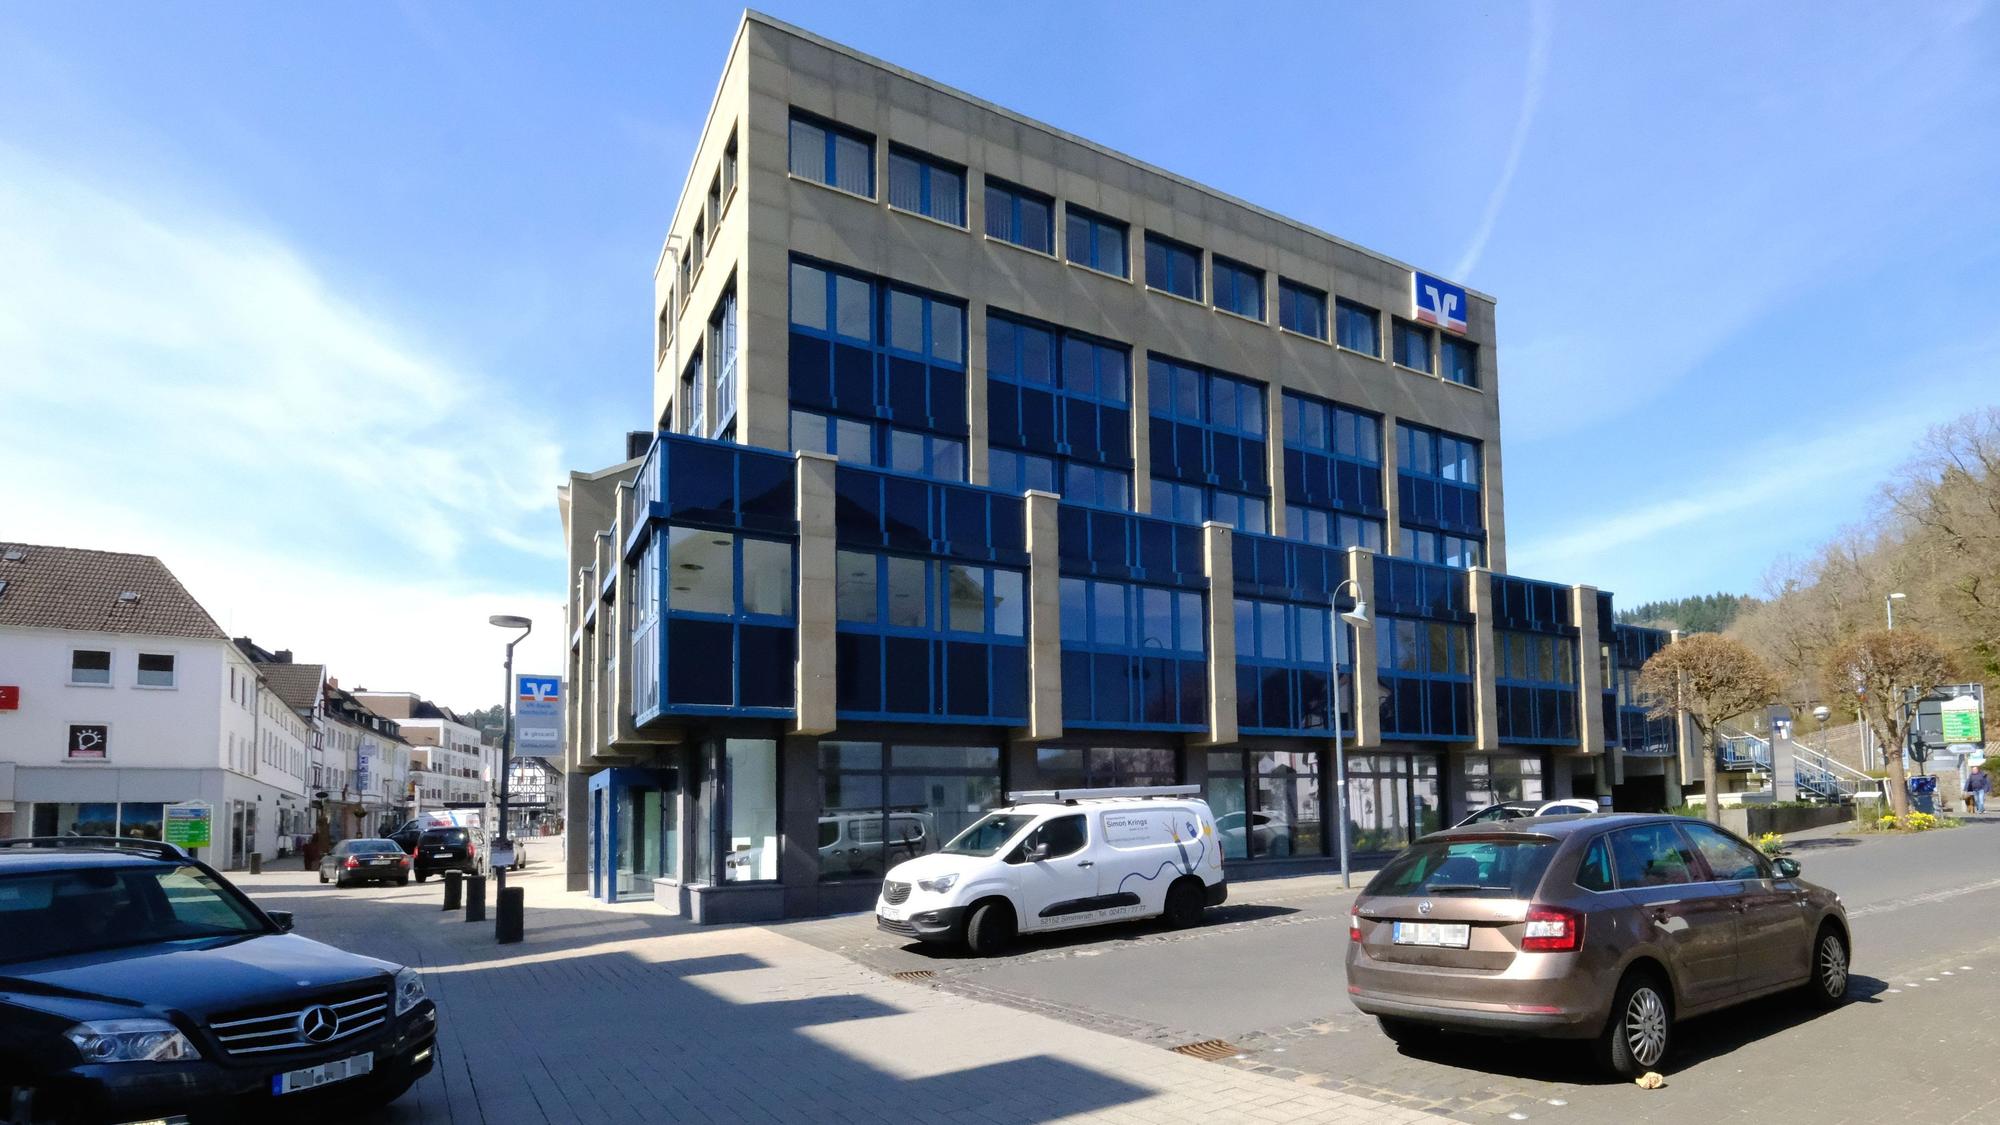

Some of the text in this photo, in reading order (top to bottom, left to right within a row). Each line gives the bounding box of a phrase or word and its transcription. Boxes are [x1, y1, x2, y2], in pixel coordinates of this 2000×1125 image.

[1106, 820, 1127, 828] Simon
[1127, 818, 1148, 827] Krings
[1062, 913, 1094, 922] Simmerath
